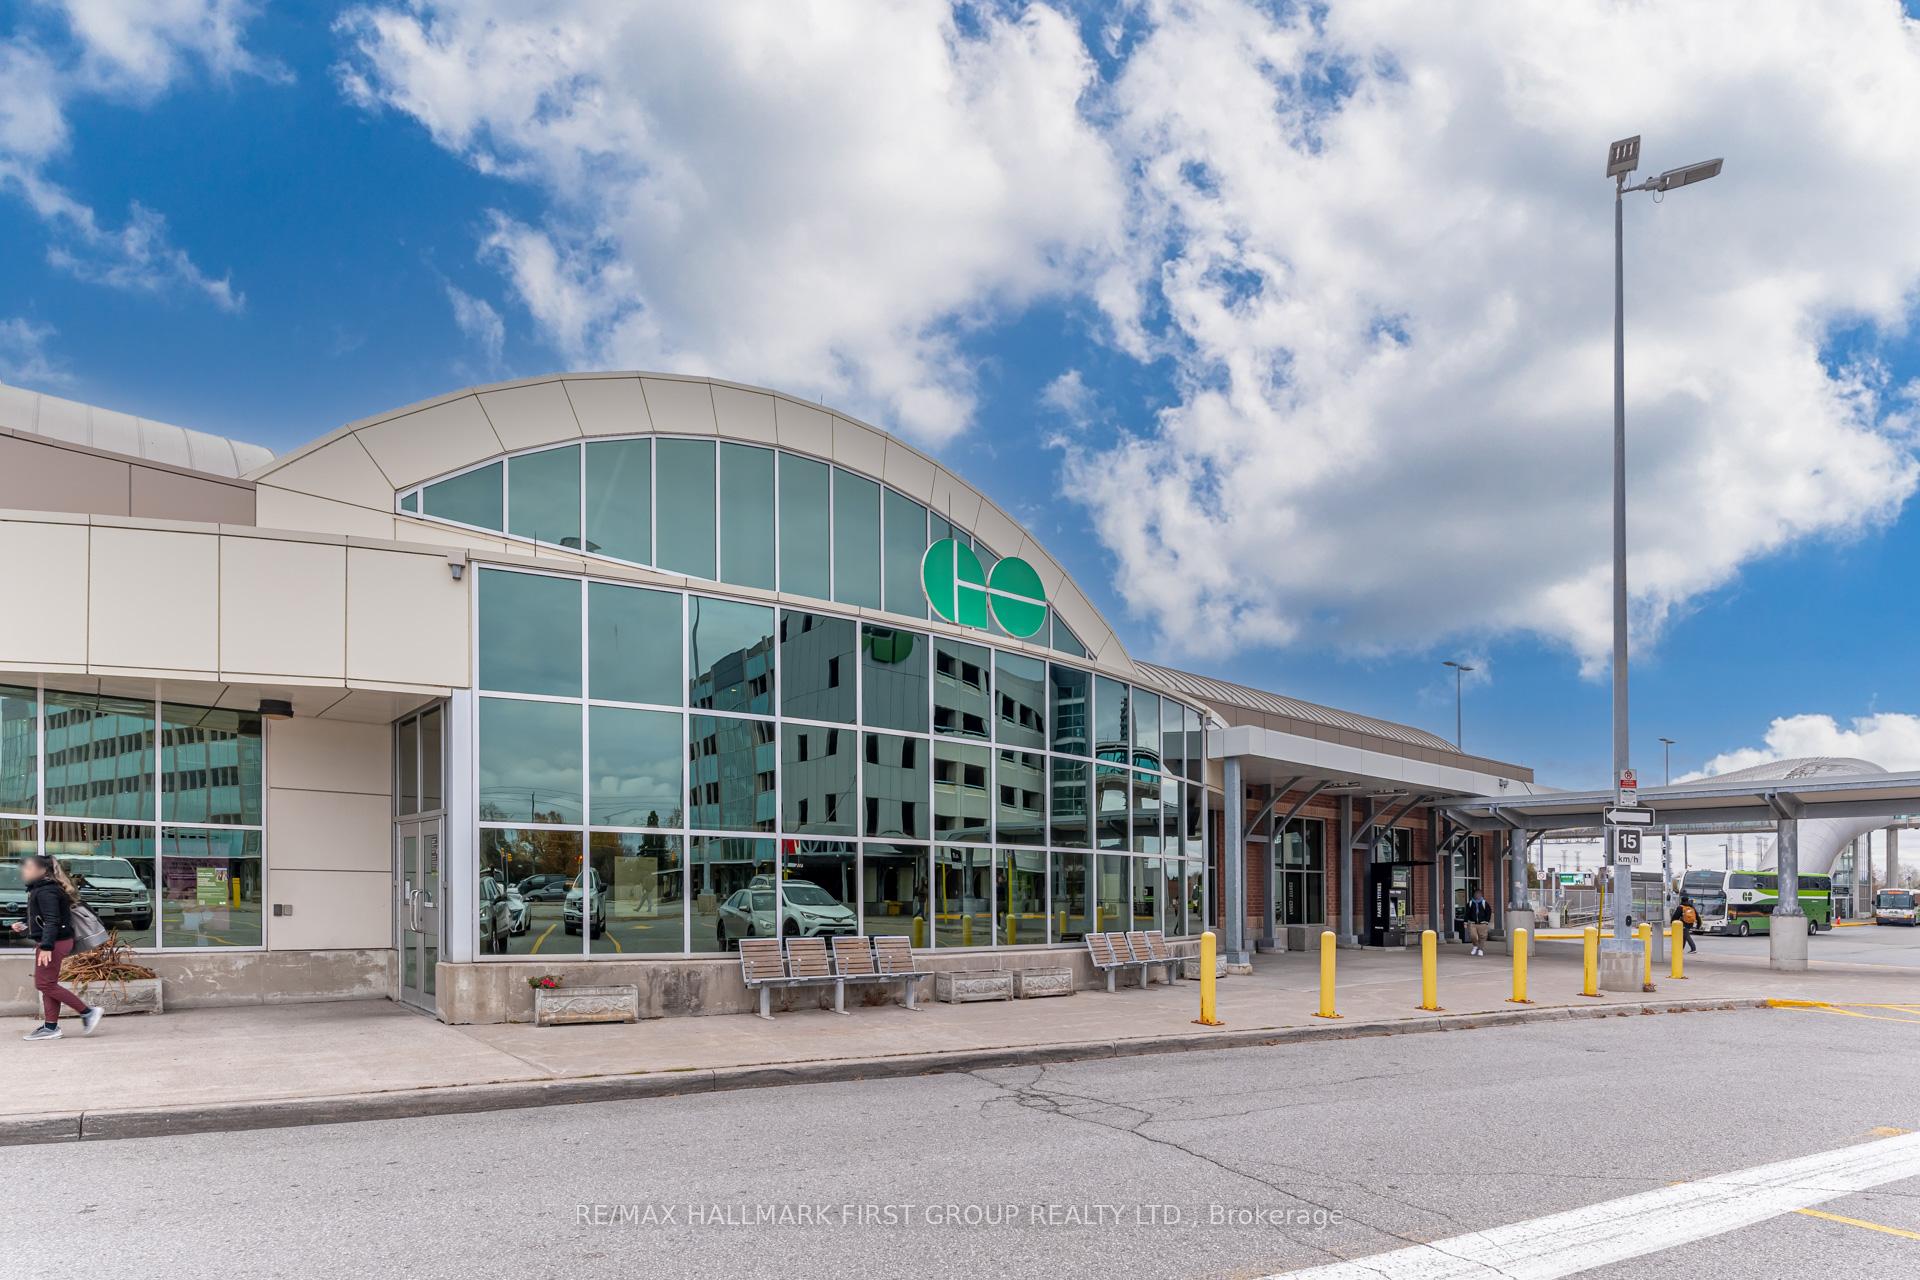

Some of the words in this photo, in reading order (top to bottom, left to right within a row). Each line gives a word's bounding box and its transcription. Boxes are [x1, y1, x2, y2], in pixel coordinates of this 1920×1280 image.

[920, 538, 1047, 638] GO
[1620, 833, 1637, 849] 15
[1618, 855, 1639, 864] km/h
[1742, 891, 1752, 902] GO
